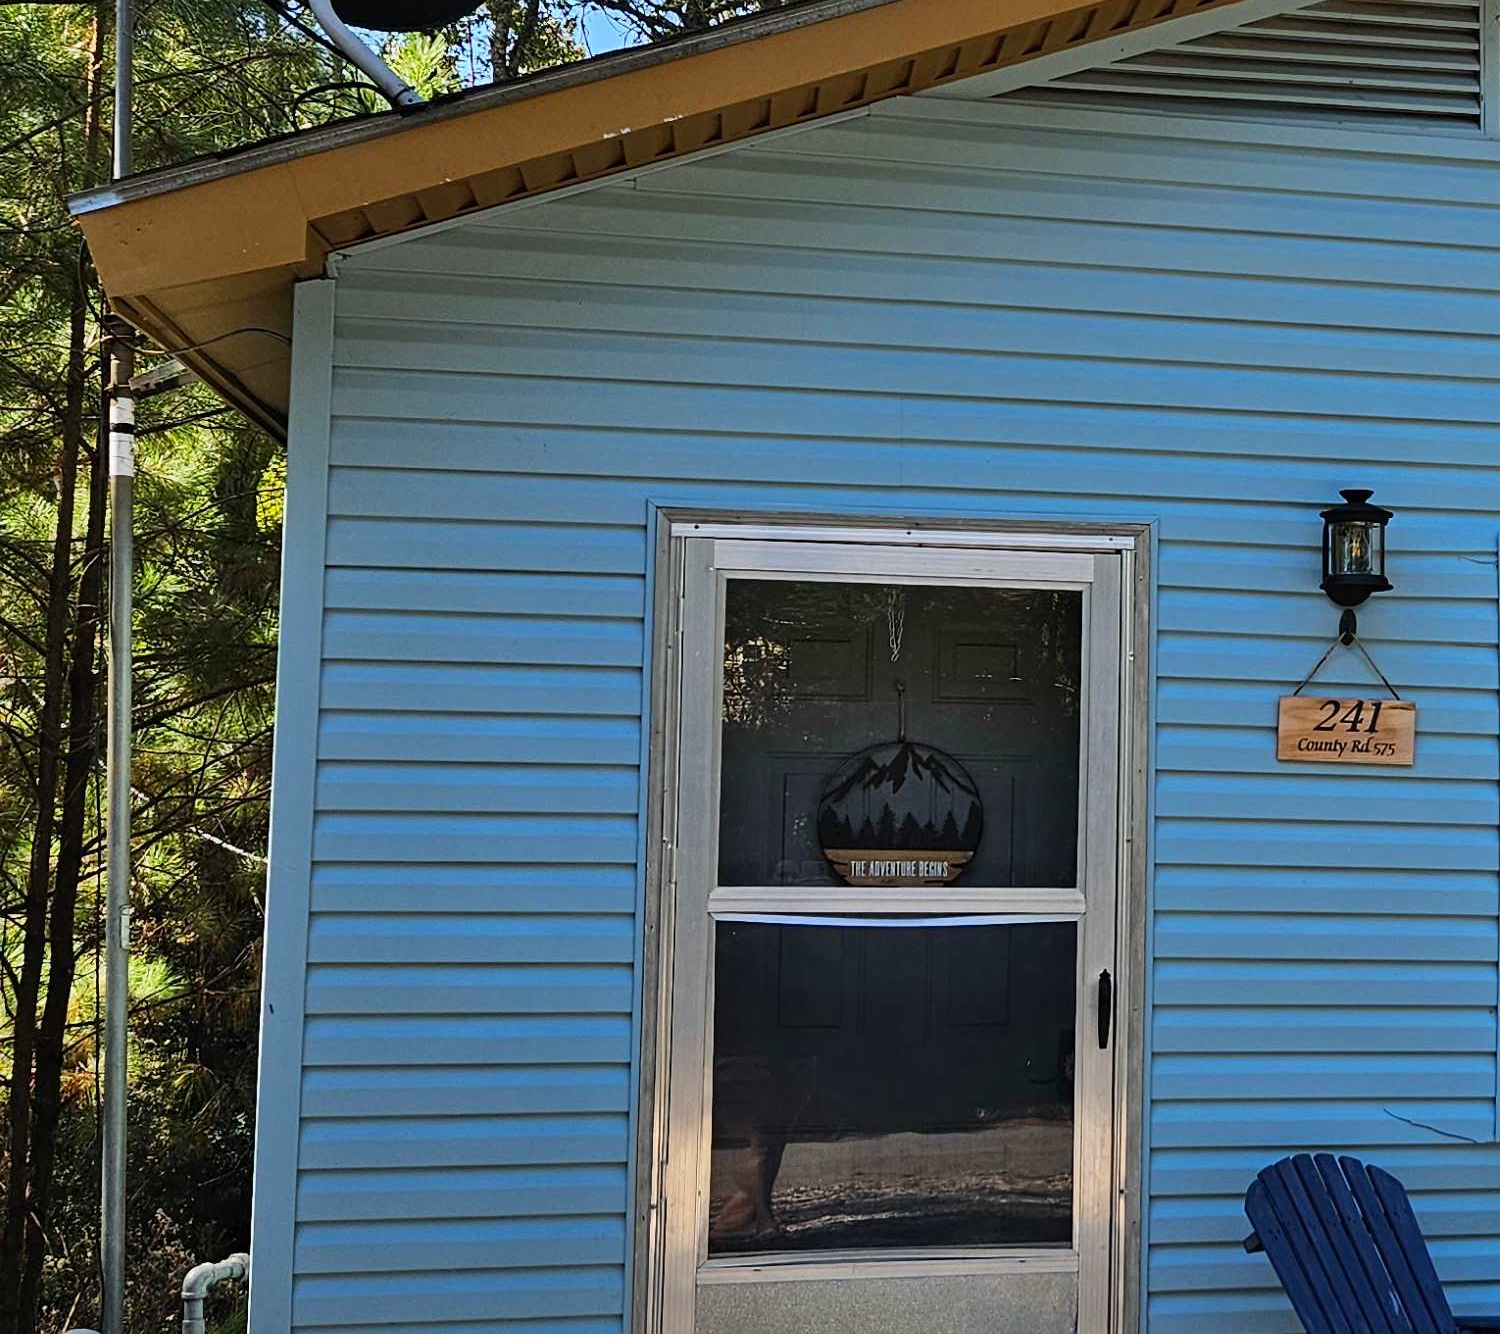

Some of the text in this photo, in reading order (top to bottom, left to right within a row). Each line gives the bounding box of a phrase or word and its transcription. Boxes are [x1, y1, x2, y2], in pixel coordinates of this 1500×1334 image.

[1313, 699, 1383, 734] 241
[1297, 736, 1396, 758] County Rd 575
[850, 860, 949, 877] THE ADVENTURE BEGINS
